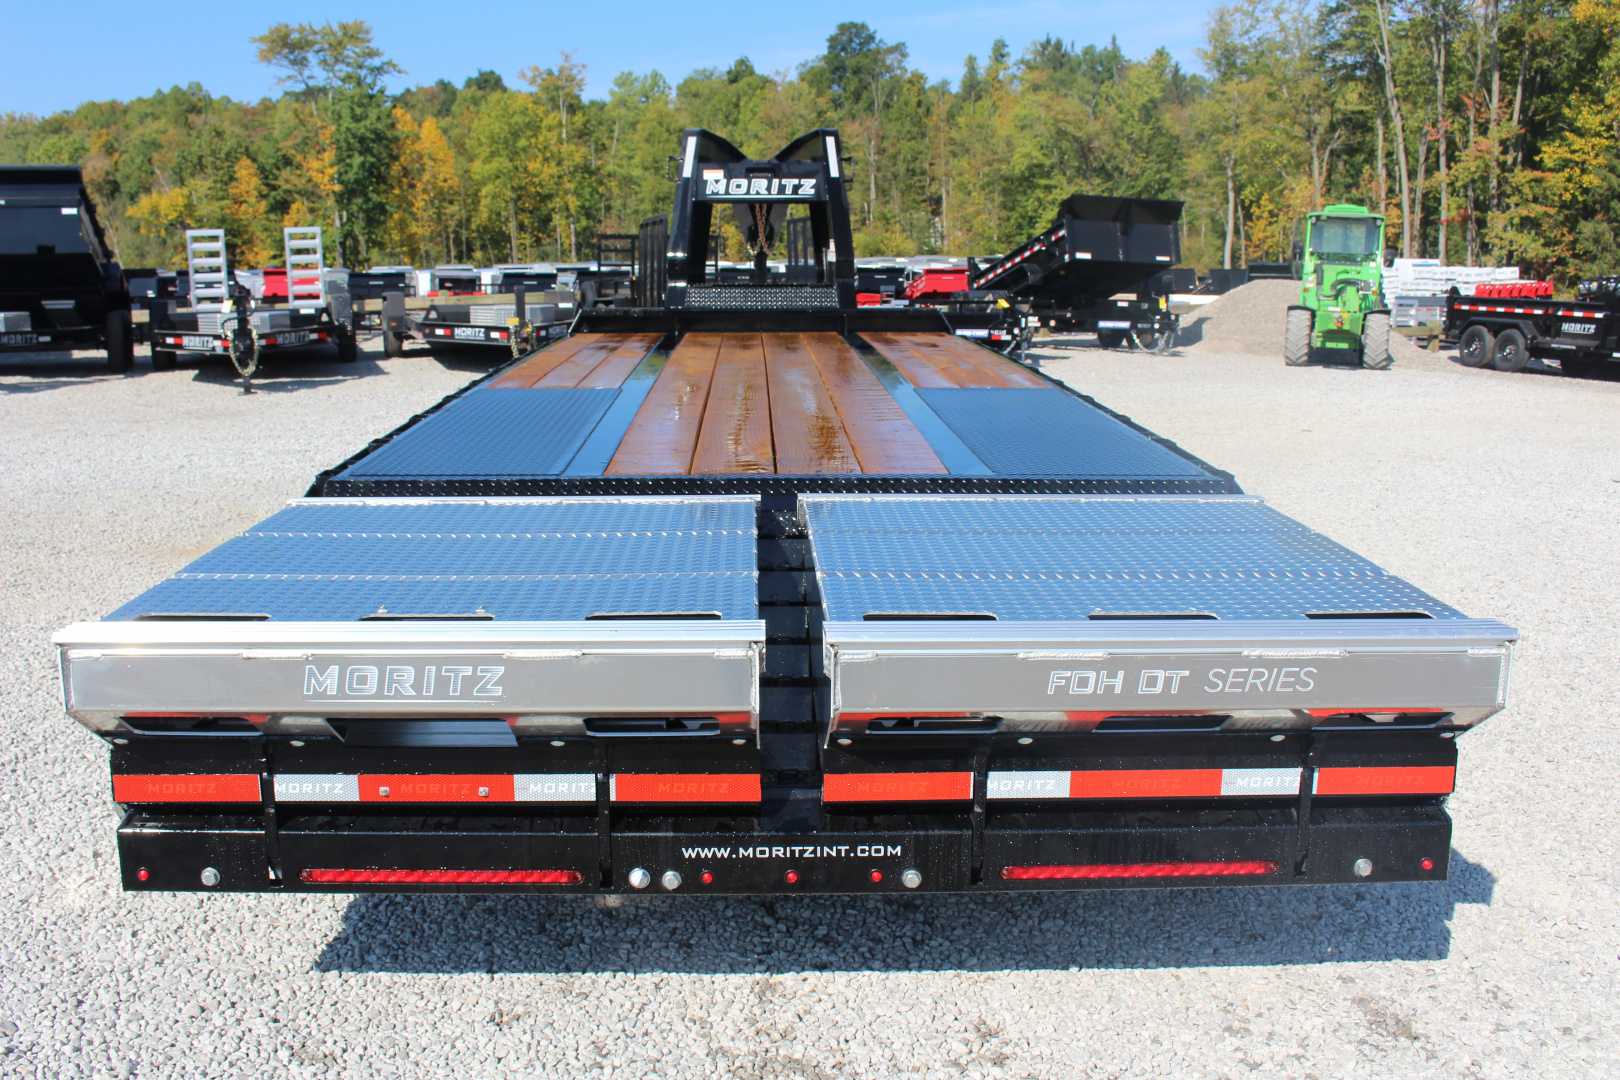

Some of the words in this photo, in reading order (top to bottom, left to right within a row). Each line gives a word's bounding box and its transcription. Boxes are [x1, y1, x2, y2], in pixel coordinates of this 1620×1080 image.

[705, 178, 817, 195] MORITZ
[454, 327, 486, 337] MORITZ
[1561, 322, 1596, 333] MORITZ
[0, 334, 38, 345] MORITZ
[182, 336, 213, 348] MORITZ
[276, 331, 310, 345] MORITZ
[303, 665, 506, 695] MORITZ
[1203, 667, 1318, 693] SERIES
[986, 780, 1056, 791] MORITZ
[1112, 778, 1181, 790] MORITZ
[1357, 774, 1426, 787] MORITZ
[148, 782, 217, 794] MORITZ
[274, 782, 344, 794] MORITZ
[400, 782, 472, 794] MORITZ
[657, 782, 730, 794] MORITZ
[858, 781, 928, 793] MORITZ
[681, 845, 902, 859] WWW.MORITZINT.COM
